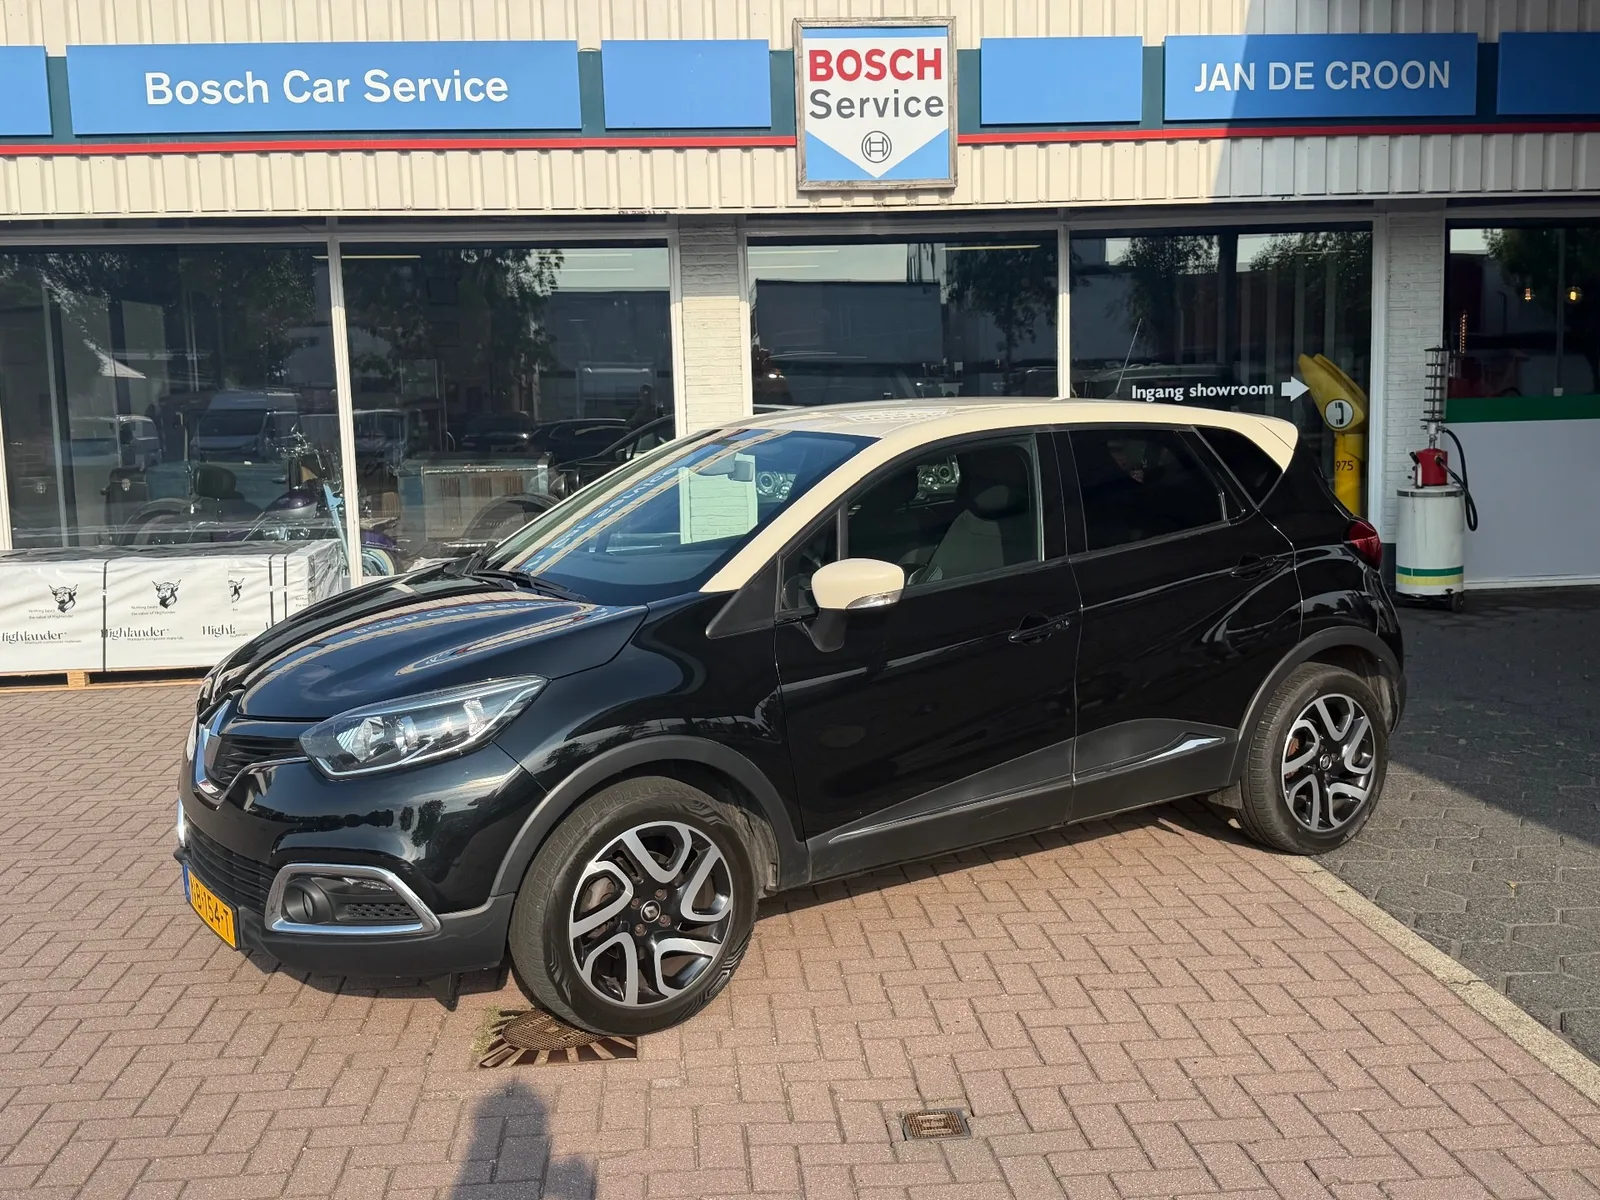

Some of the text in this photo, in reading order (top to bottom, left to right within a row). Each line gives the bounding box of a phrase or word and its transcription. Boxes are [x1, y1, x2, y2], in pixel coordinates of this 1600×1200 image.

[809, 48, 942, 82] BOSCH
[1194, 60, 1450, 93] JAN DE CROON
[145, 69, 508, 105] Bosch Car Service
[809, 89, 944, 119] Service
[1131, 383, 1274, 402] Ingang showroom
[1336, 460, 1354, 471] 975
[1, 630, 64, 645] ighlander
